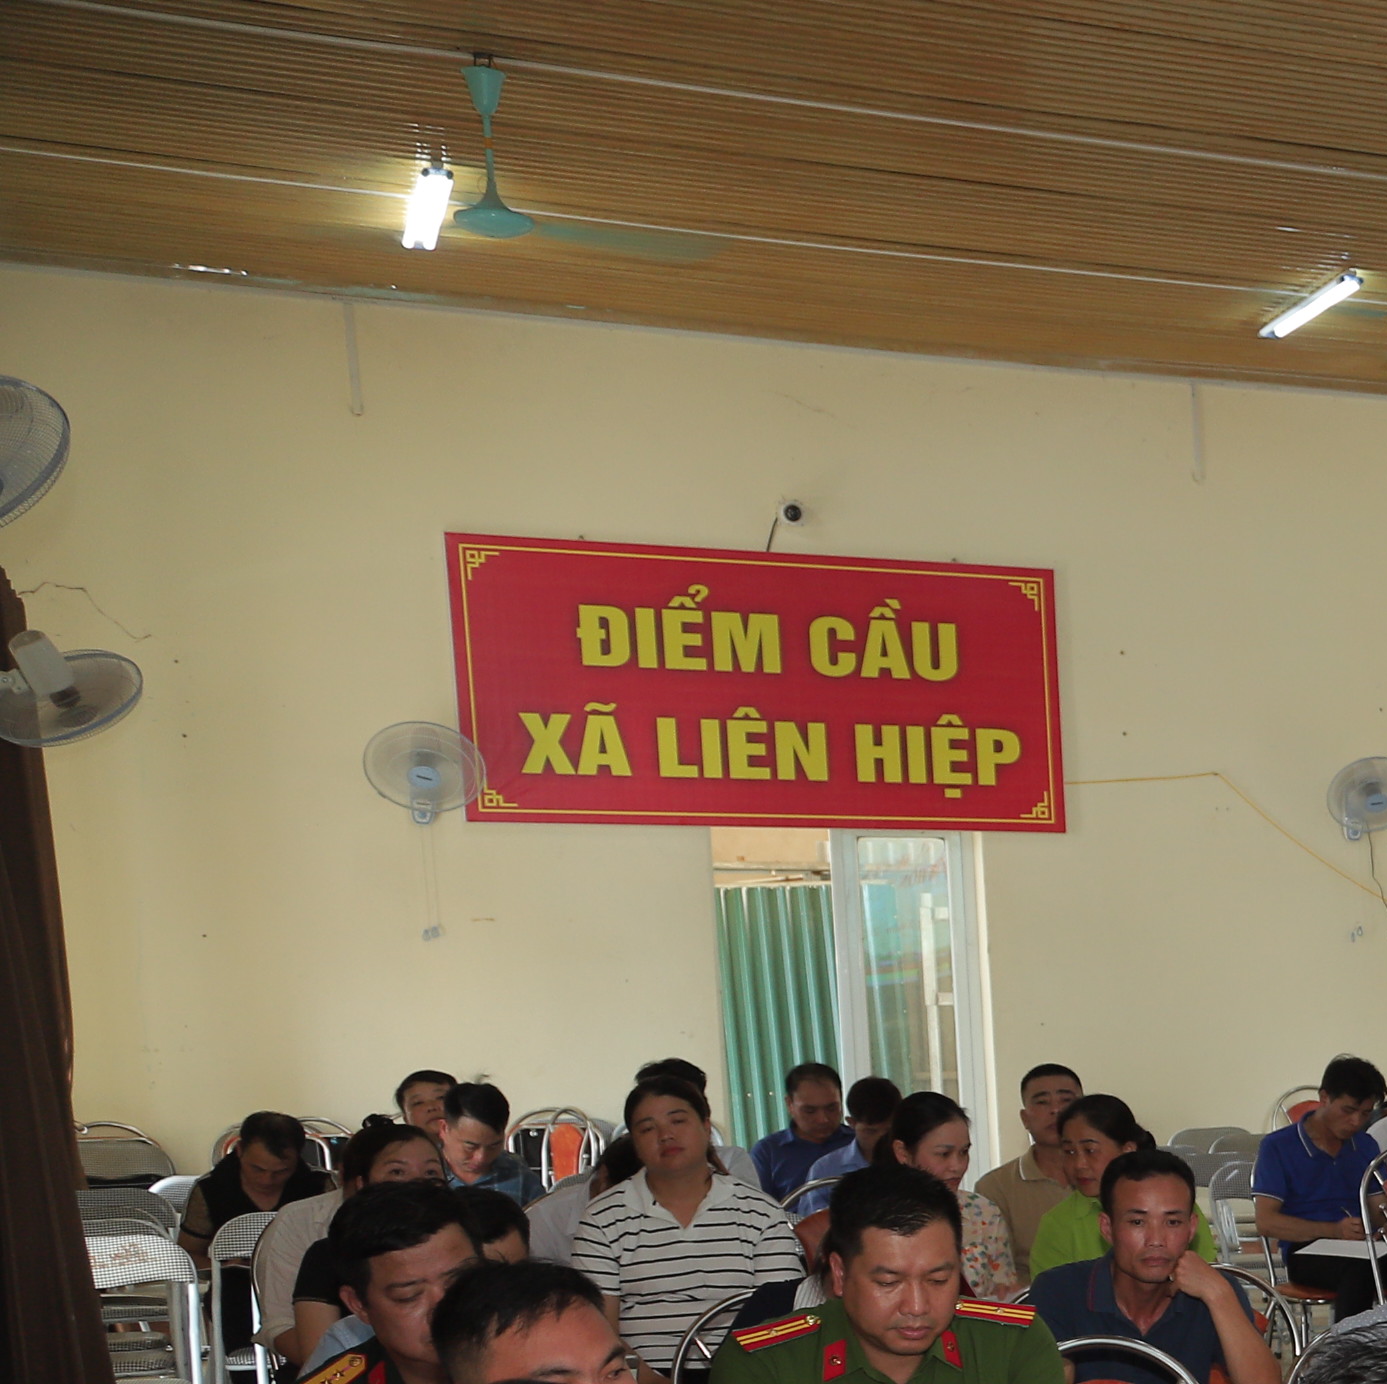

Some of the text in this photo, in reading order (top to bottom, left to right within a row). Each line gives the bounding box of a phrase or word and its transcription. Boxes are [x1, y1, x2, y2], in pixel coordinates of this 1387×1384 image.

[577, 584, 958, 681] ĐIỂM CẦU
[519, 702, 1021, 798] XÃ LIÊN HIỆP
